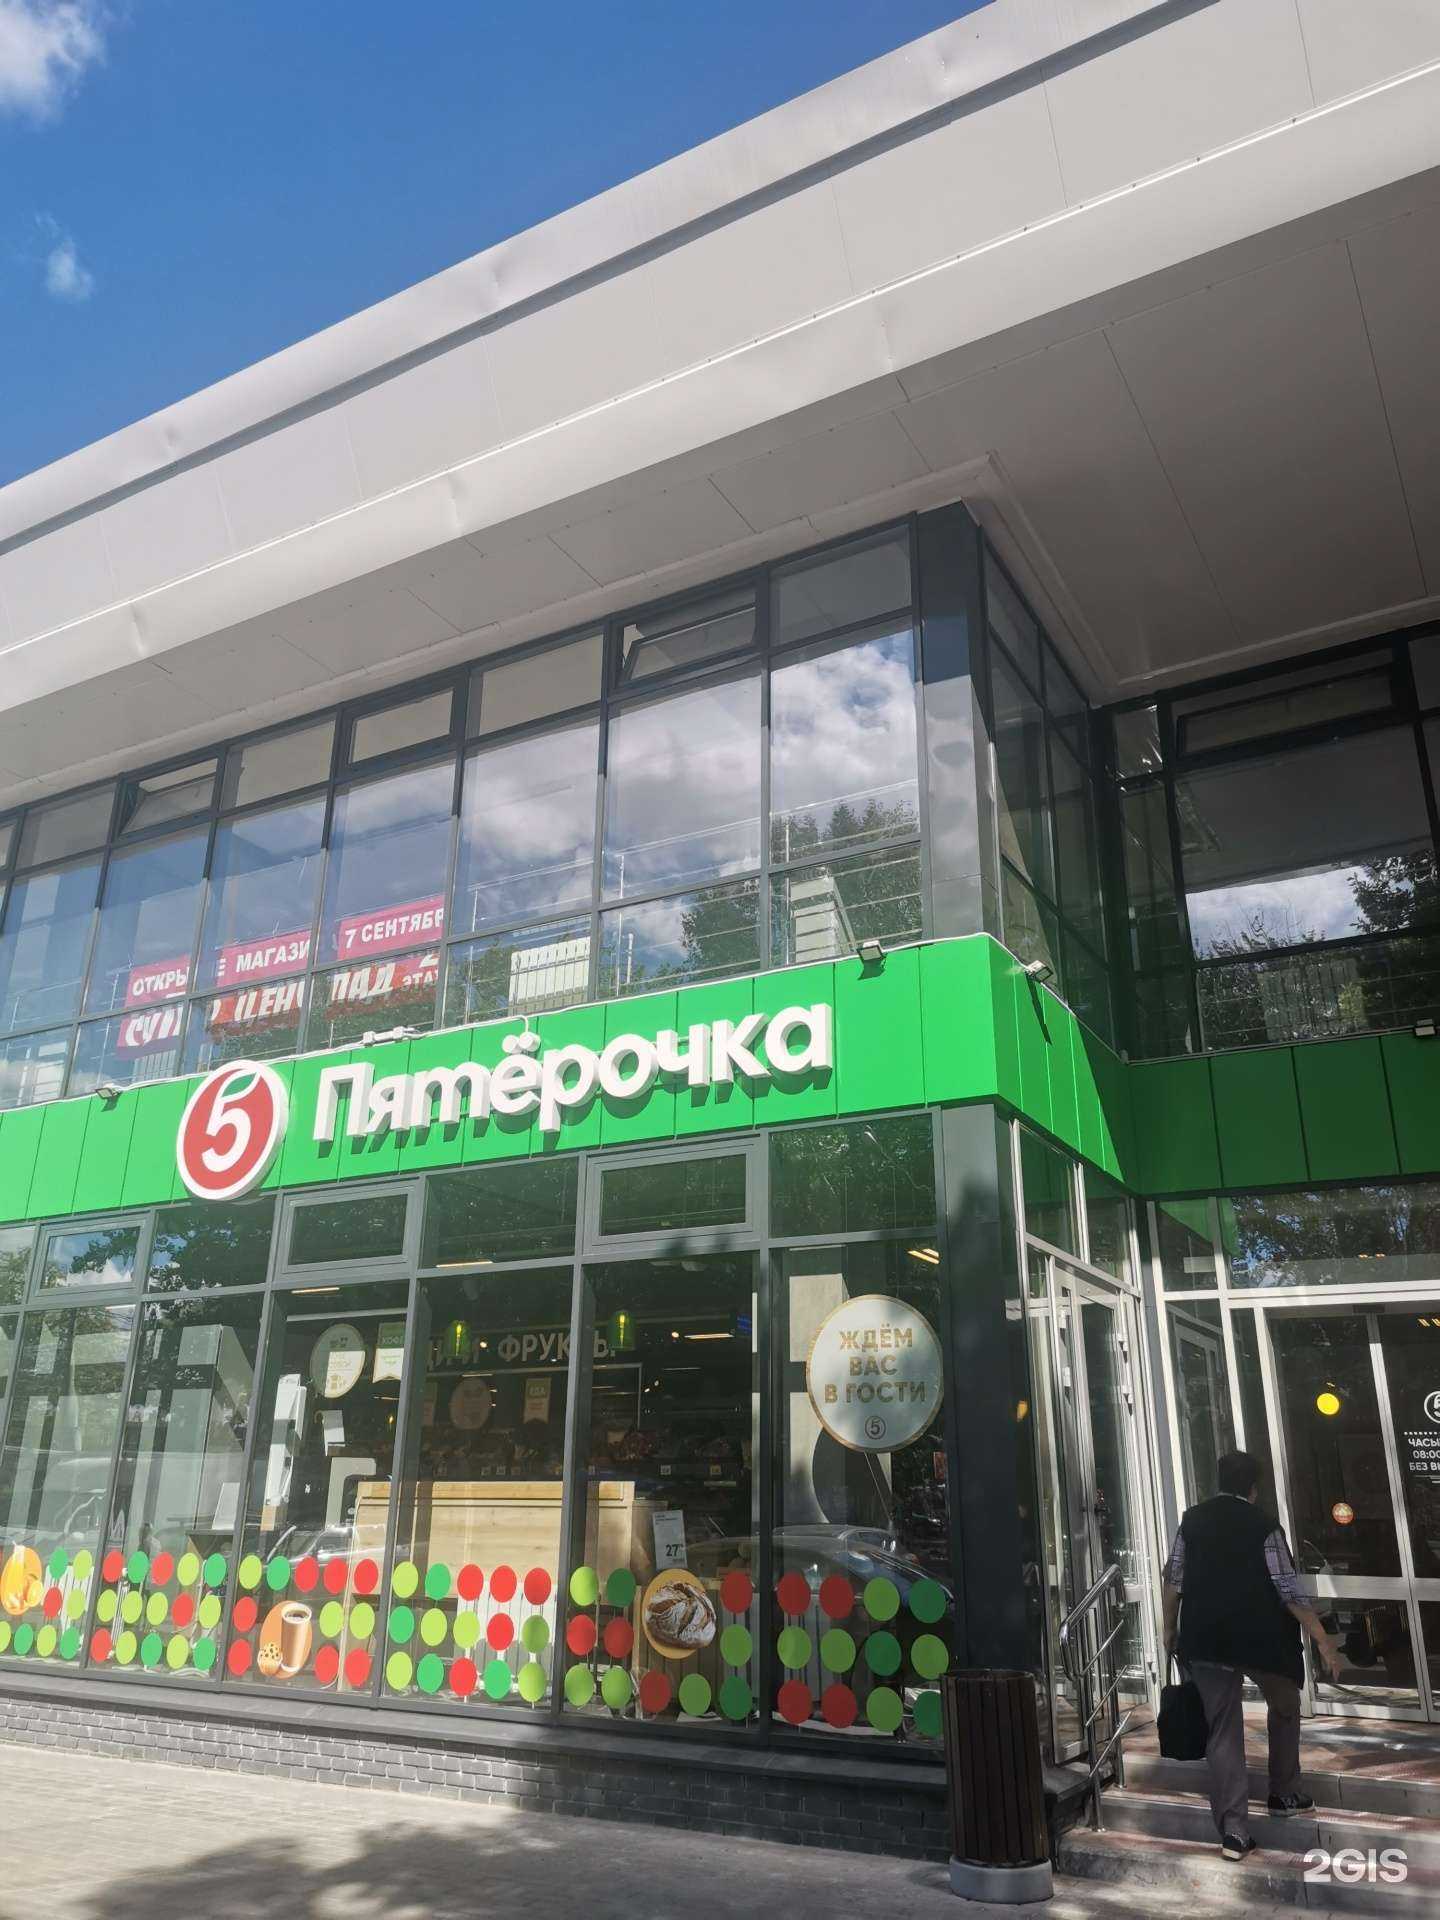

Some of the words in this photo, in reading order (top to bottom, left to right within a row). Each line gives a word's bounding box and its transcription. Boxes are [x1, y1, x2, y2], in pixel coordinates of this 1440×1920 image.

[236, 939, 310, 972] МАГАЗИ
[345, 928, 356, 949] 7
[361, 908, 444, 942] СЕНТЯБР
[402, 969, 439, 986] ЭТА
[313, 1003, 832, 1142] Пятёрочка
[839, 1323, 913, 1352] ЖДЁМ
[850, 1355, 897, 1377] ВАС
[824, 1383, 838, 1404] В
[846, 1381, 926, 1404] ГОСТИ
[1409, 1461, 1428, 1471] БЕЗ
